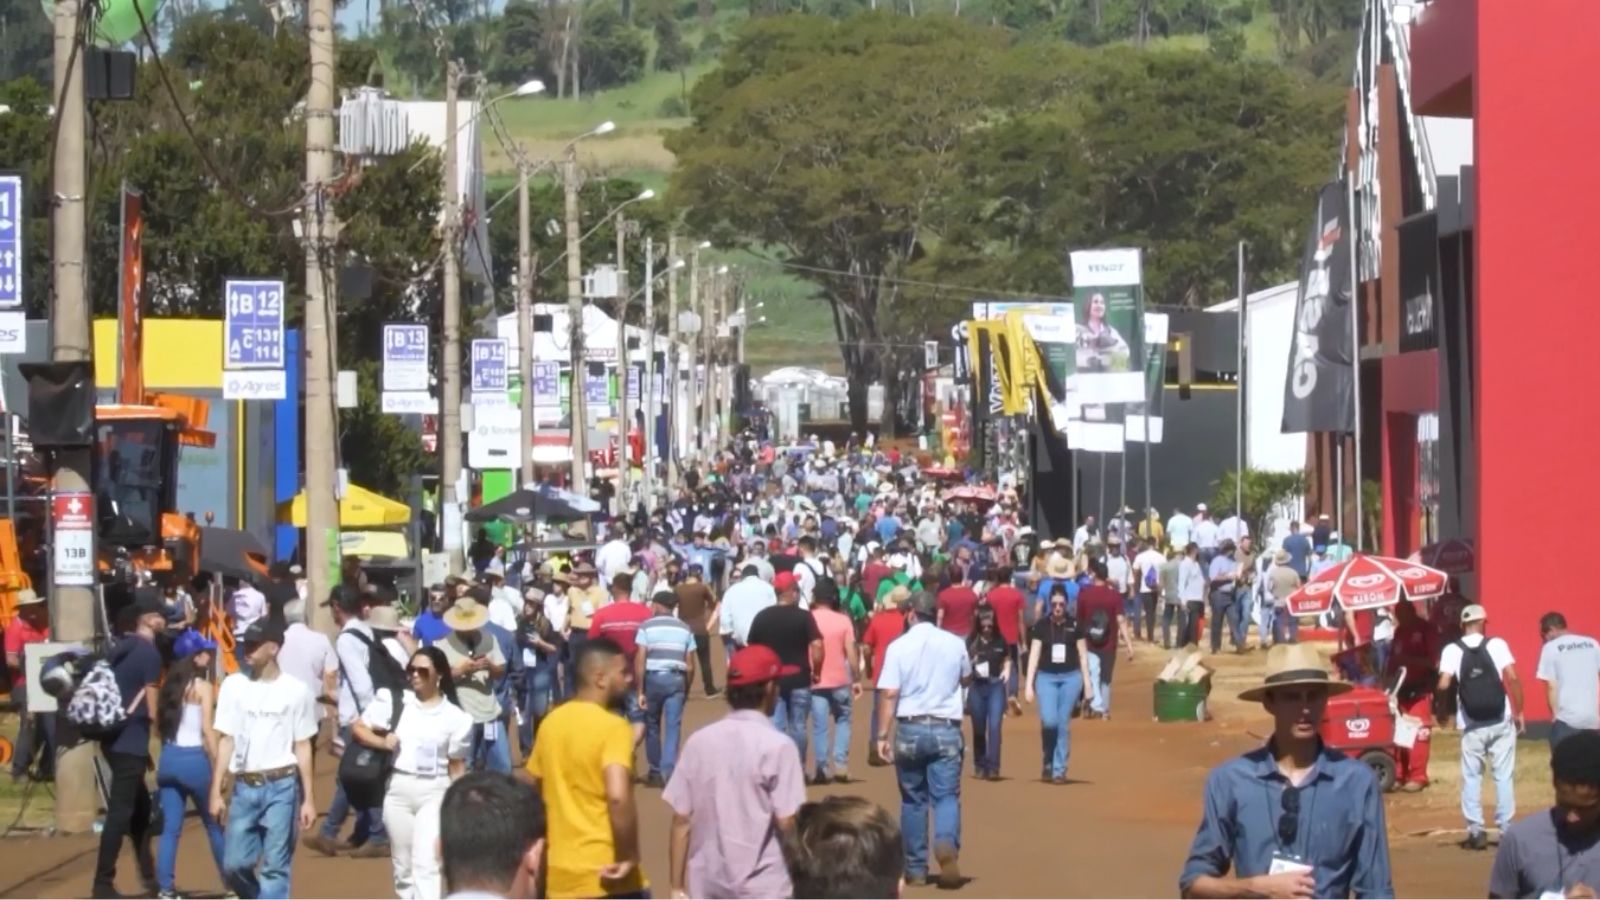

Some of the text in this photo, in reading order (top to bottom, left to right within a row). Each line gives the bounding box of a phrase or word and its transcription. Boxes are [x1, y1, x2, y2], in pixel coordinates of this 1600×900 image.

[240, 290, 279, 314] B 12
[231, 338, 242, 354] A
[242, 334, 253, 349] C
[394, 329, 424, 348] B 13
[480, 344, 504, 360] B 14
[64, 548, 86, 558] 13B
